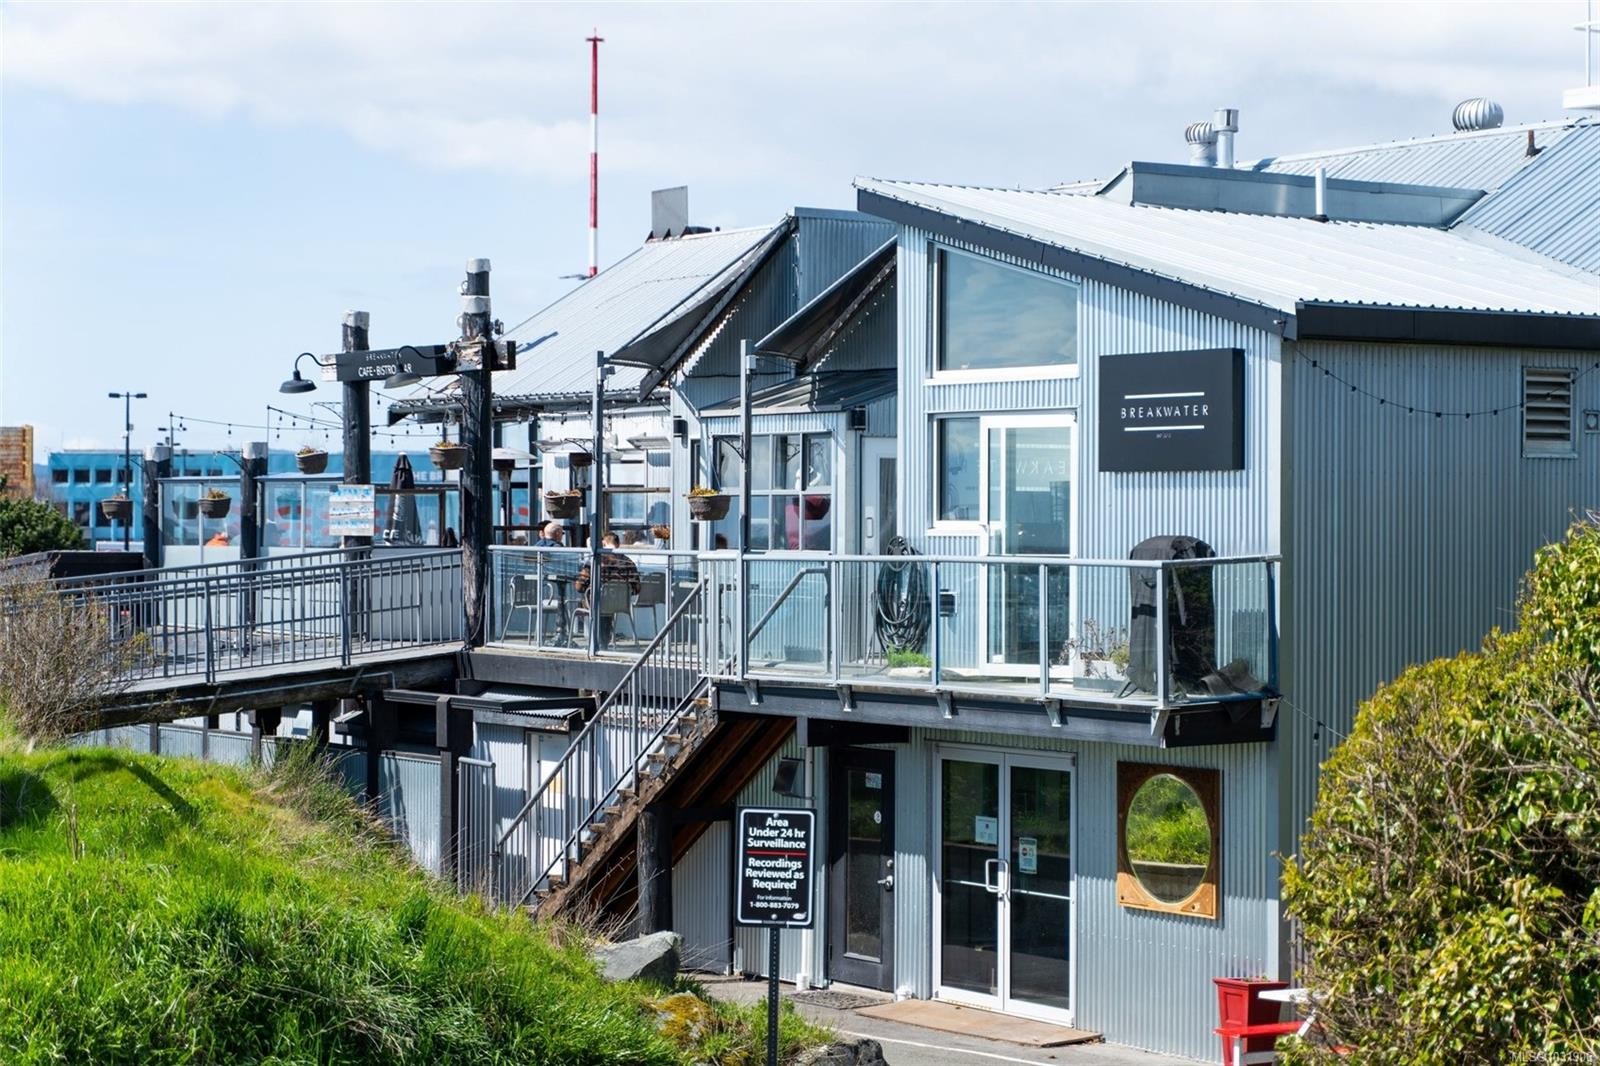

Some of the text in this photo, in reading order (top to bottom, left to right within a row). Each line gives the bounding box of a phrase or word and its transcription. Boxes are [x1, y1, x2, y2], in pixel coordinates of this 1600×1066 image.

[1120, 404, 1209, 419] BREAKWATER
[765, 817, 789, 827] Area
[748, 827, 806, 838] Under 24 hr
[747, 838, 806, 849] Surveillance
[748, 858, 802, 870] Recordings
[745, 868, 804, 880] Reviewed as
[752, 879, 797, 891] Required
[749, 901, 799, 909] 1-800-883-7079
